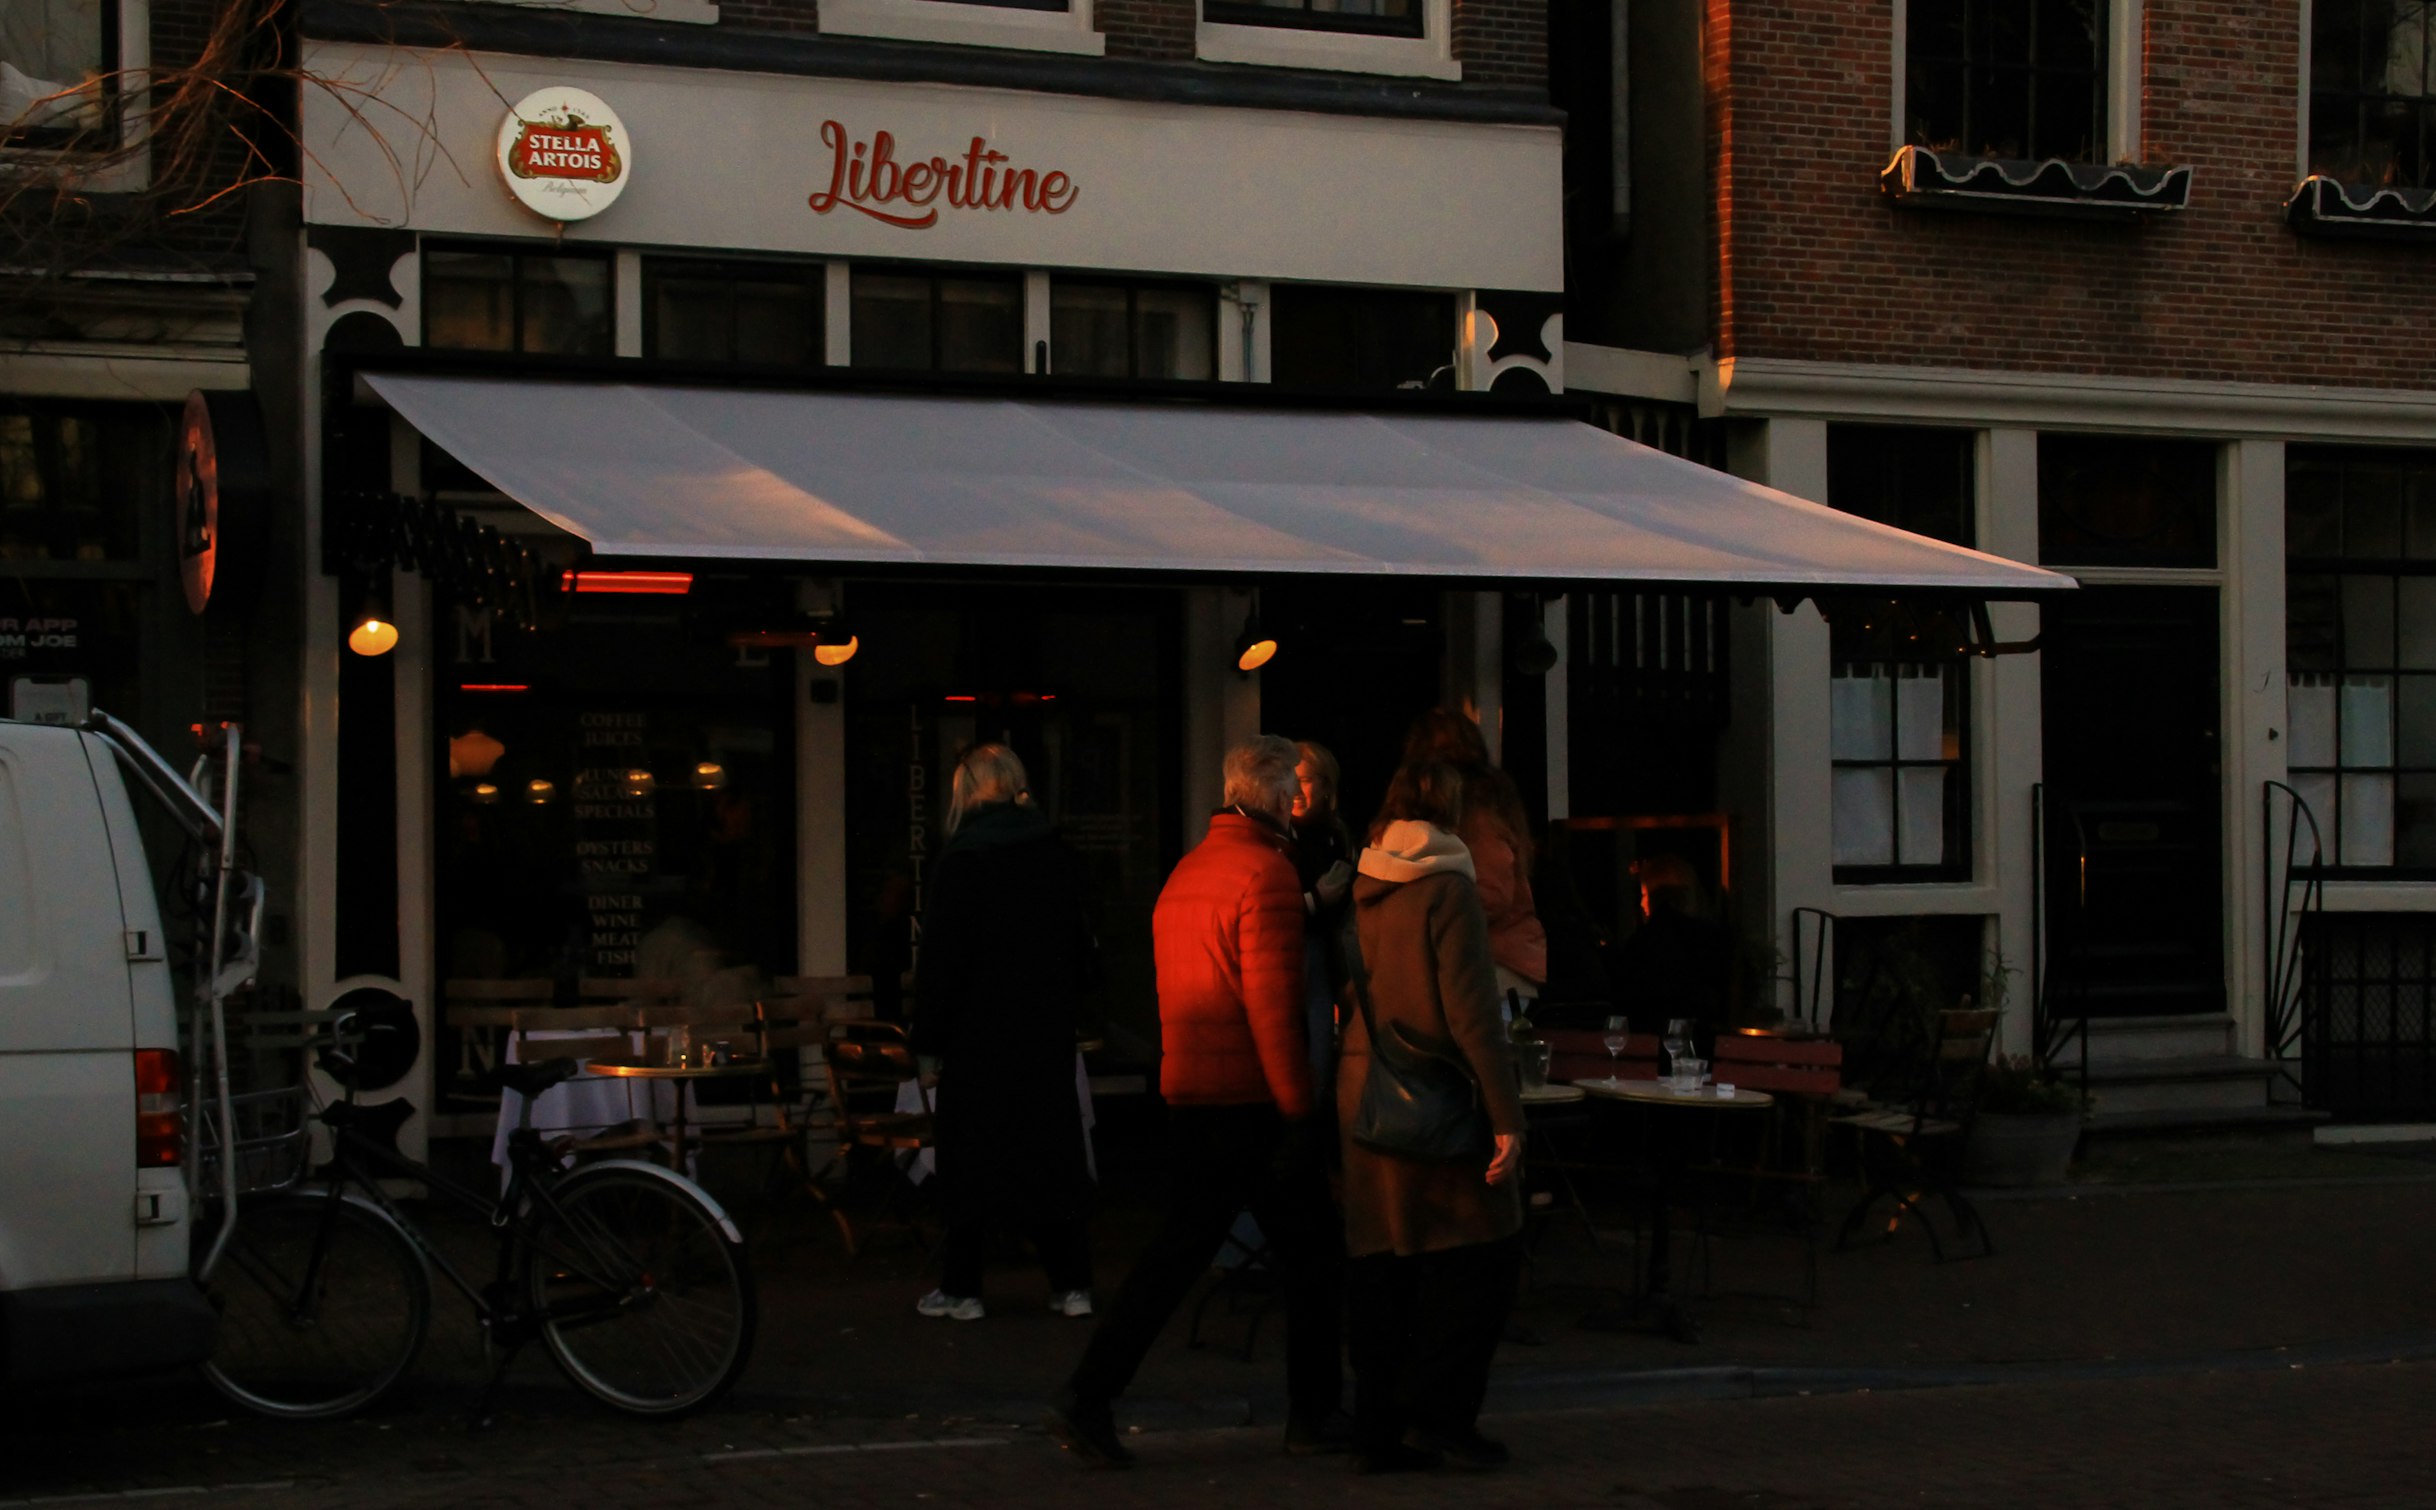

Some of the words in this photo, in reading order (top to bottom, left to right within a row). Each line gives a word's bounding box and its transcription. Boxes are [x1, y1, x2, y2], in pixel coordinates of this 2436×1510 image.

[529, 134, 601, 153] STELLA
[528, 151, 602, 170] ARTOIS
[809, 119, 1079, 229] Libertine
[25, 617, 79, 632] APP
[30, 634, 78, 648] JOE
[580, 712, 647, 728] COFFEE
[584, 731, 643, 747] JUICES
[574, 804, 656, 819] SPECIALS
[576, 840, 655, 856] OYSTERS
[580, 859, 649, 873] SNACKS
[588, 896, 645, 910] DINER
[591, 914, 640, 928] WINE
[592, 932, 641, 946] MEAT
[597, 950, 637, 965] FISH
